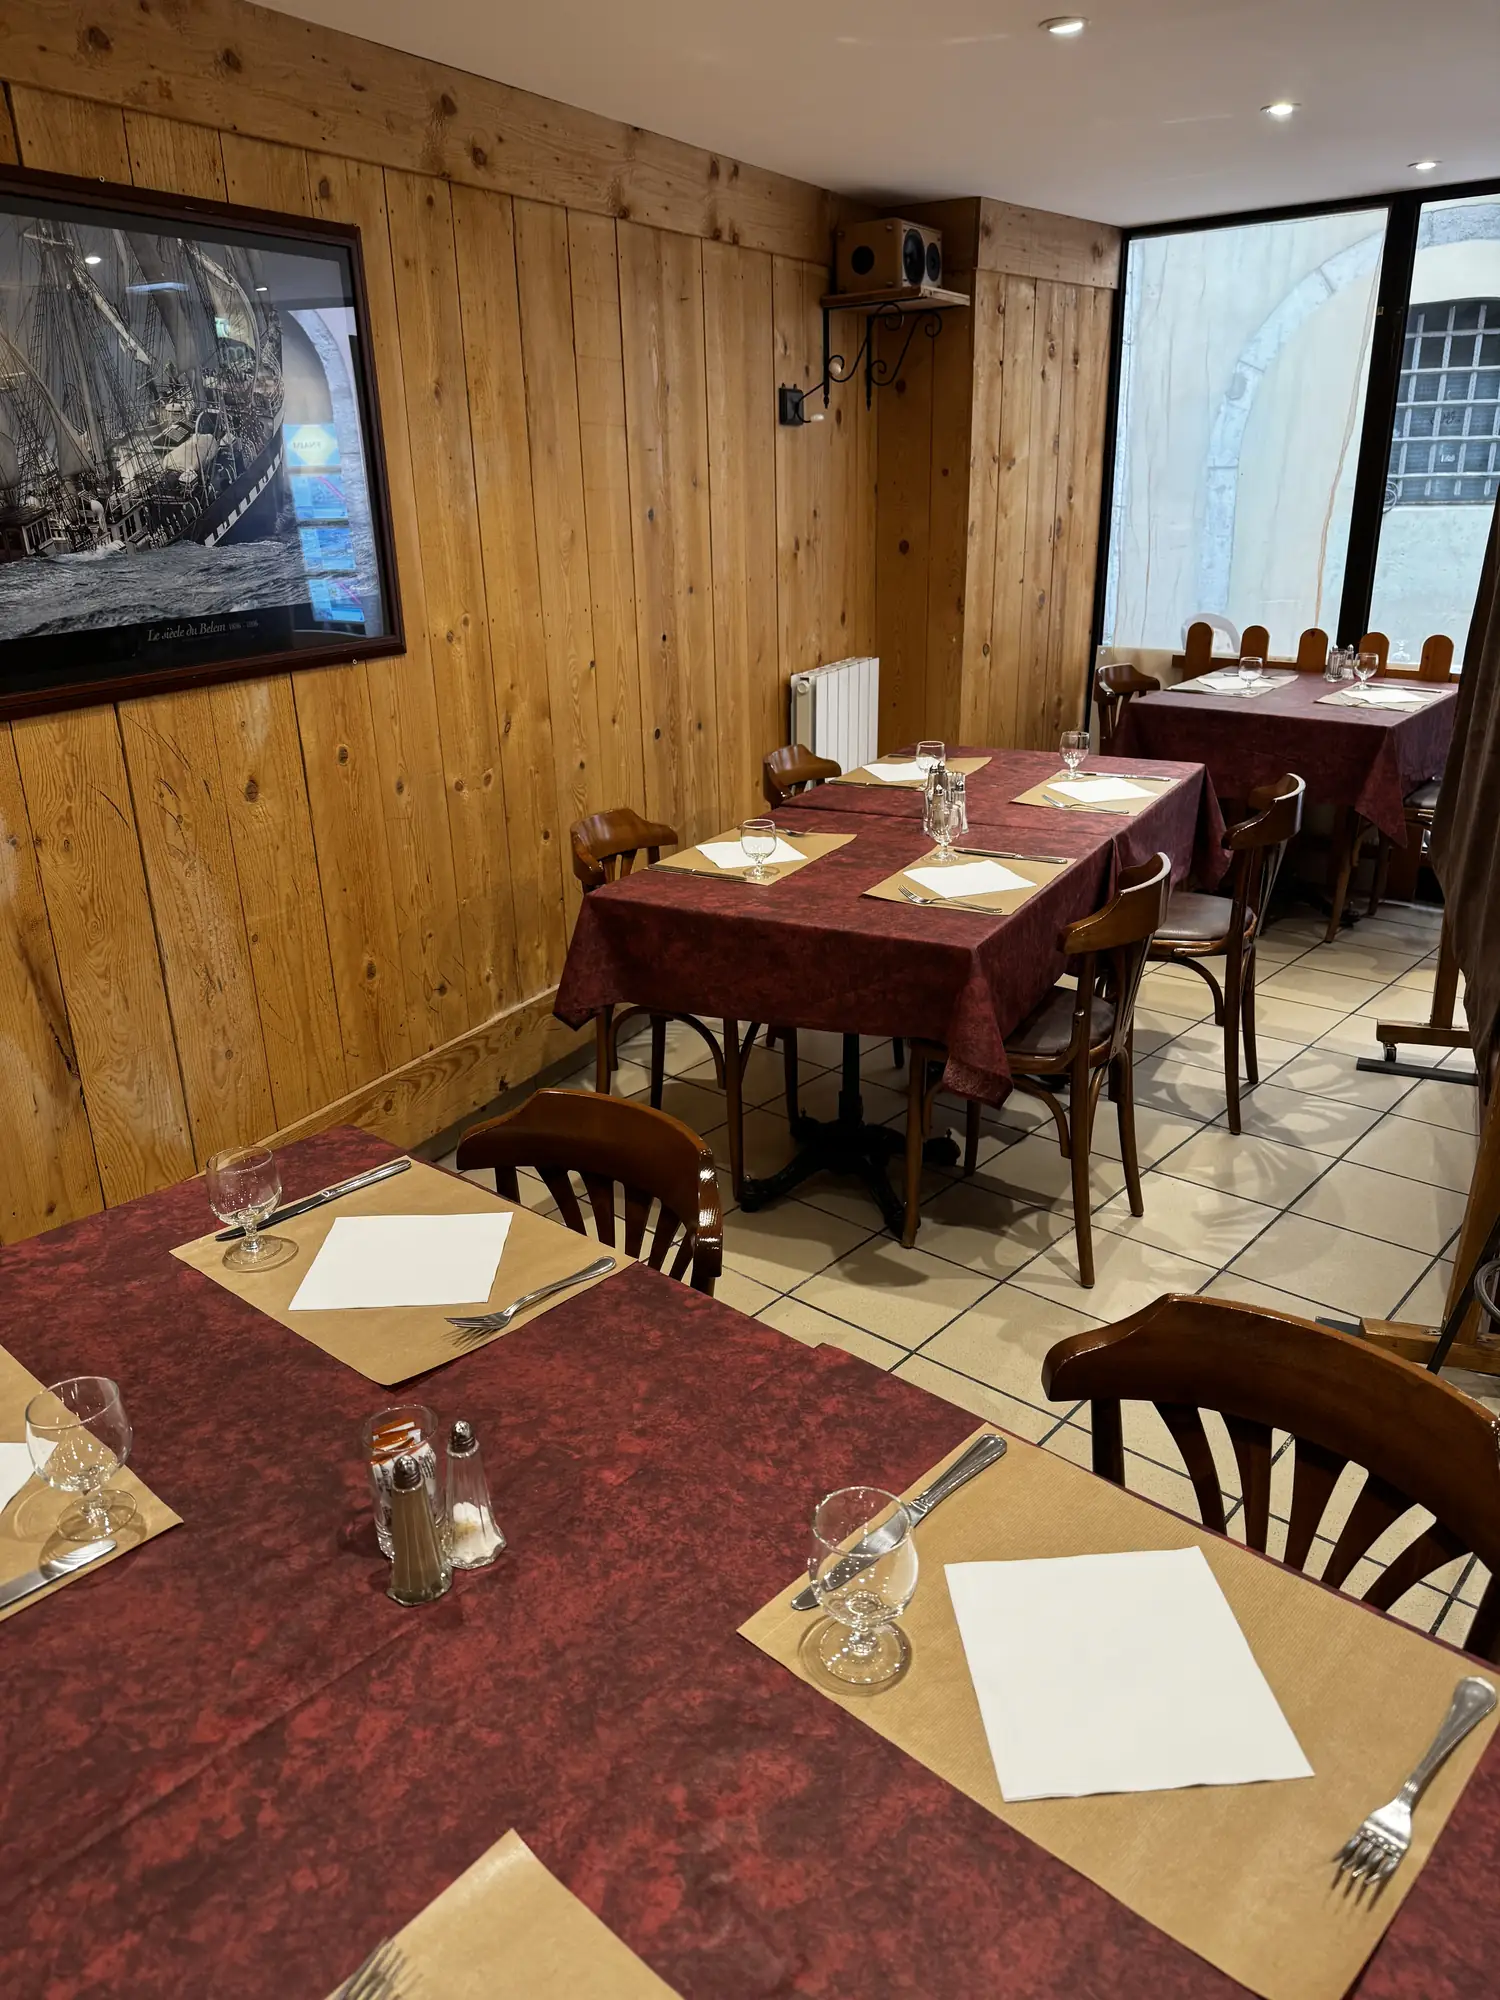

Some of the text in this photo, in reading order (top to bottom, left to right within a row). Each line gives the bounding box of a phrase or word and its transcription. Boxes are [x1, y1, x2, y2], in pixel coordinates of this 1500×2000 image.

[147, 629, 160, 641] Le
[161, 625, 184, 639] siècle
[186, 623, 197, 636] du
[199, 620, 226, 635] Belem
